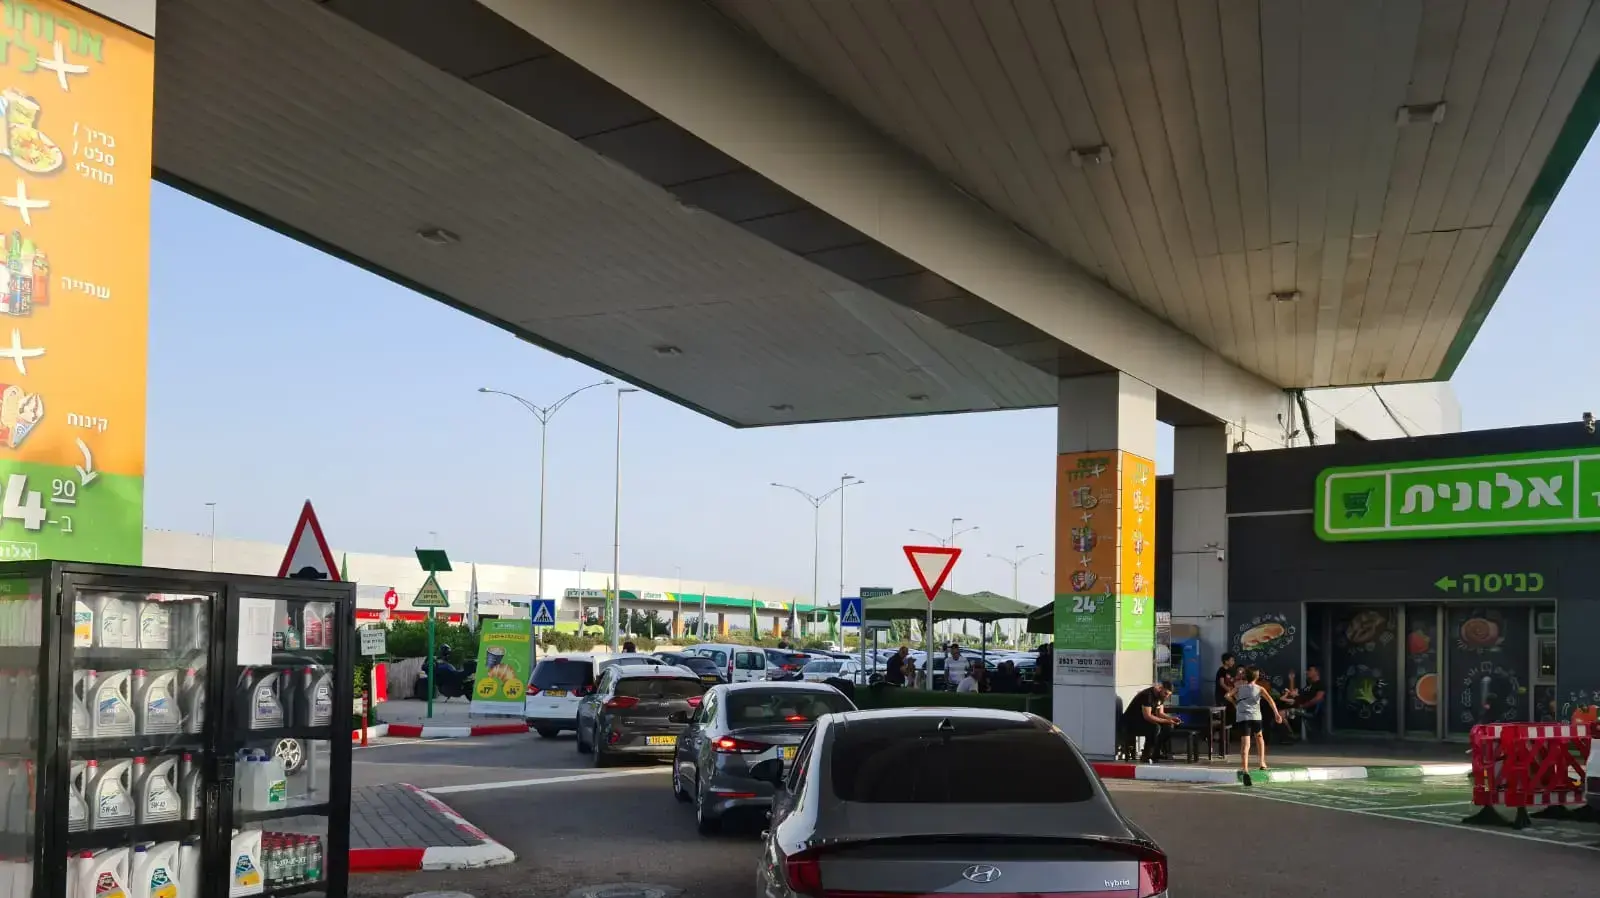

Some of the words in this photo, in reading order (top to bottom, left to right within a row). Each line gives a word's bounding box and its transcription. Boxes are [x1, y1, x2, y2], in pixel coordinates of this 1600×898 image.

[84, 145, 115, 167] סלט
[61, 276, 111, 299] שתייה
[67, 412, 109, 431] קינוח
[52, 478, 76, 497] 90
[1399, 472, 1564, 515] אלונית
[0, 473, 47, 530] 4
[0, 544, 31, 559] אלו
[1462, 572, 1545, 594] כניסה
[1072, 595, 1097, 613] 24
[1104, 879, 1130, 888] hybrid
